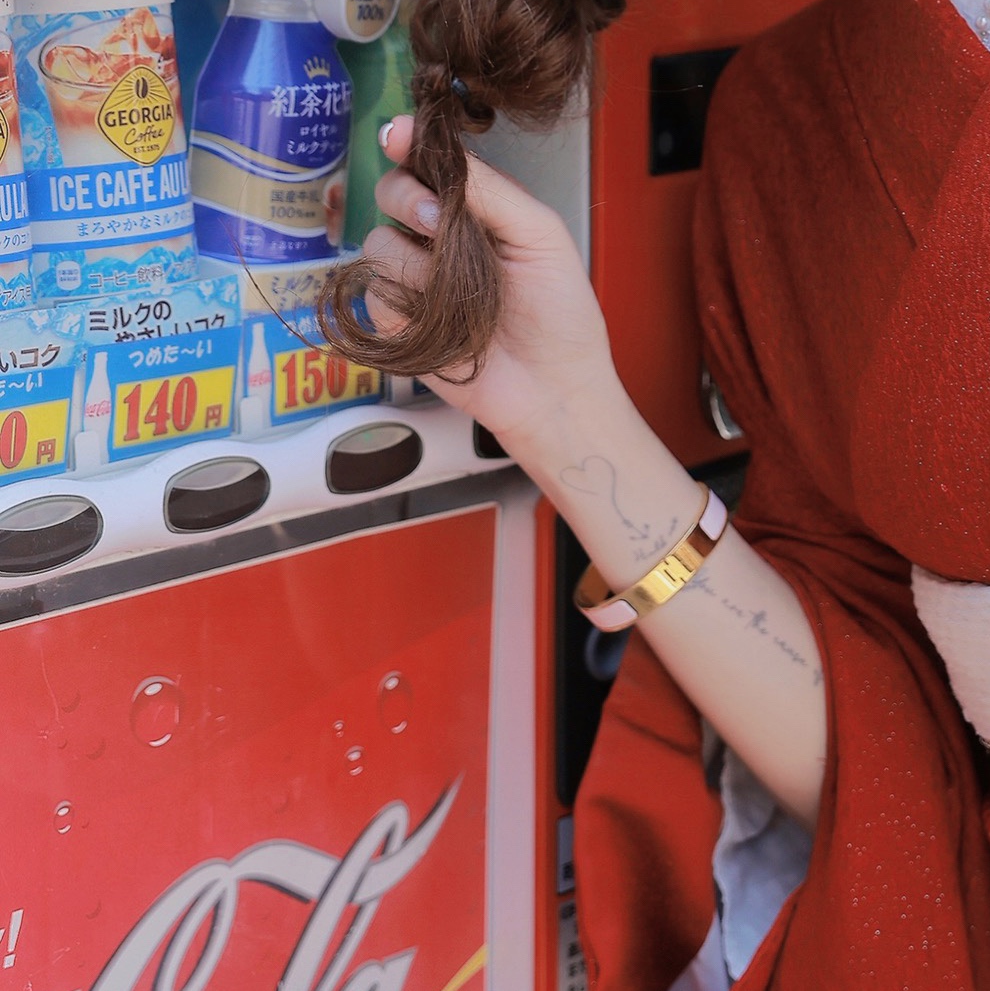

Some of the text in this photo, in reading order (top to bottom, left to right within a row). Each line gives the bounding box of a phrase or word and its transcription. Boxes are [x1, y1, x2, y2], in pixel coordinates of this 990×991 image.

[104, 104, 174, 128] GEORGIA
[124, 125, 165, 145] Coffee
[50, 170, 93, 212] ICE
[89, 300, 172, 331] ミルクの
